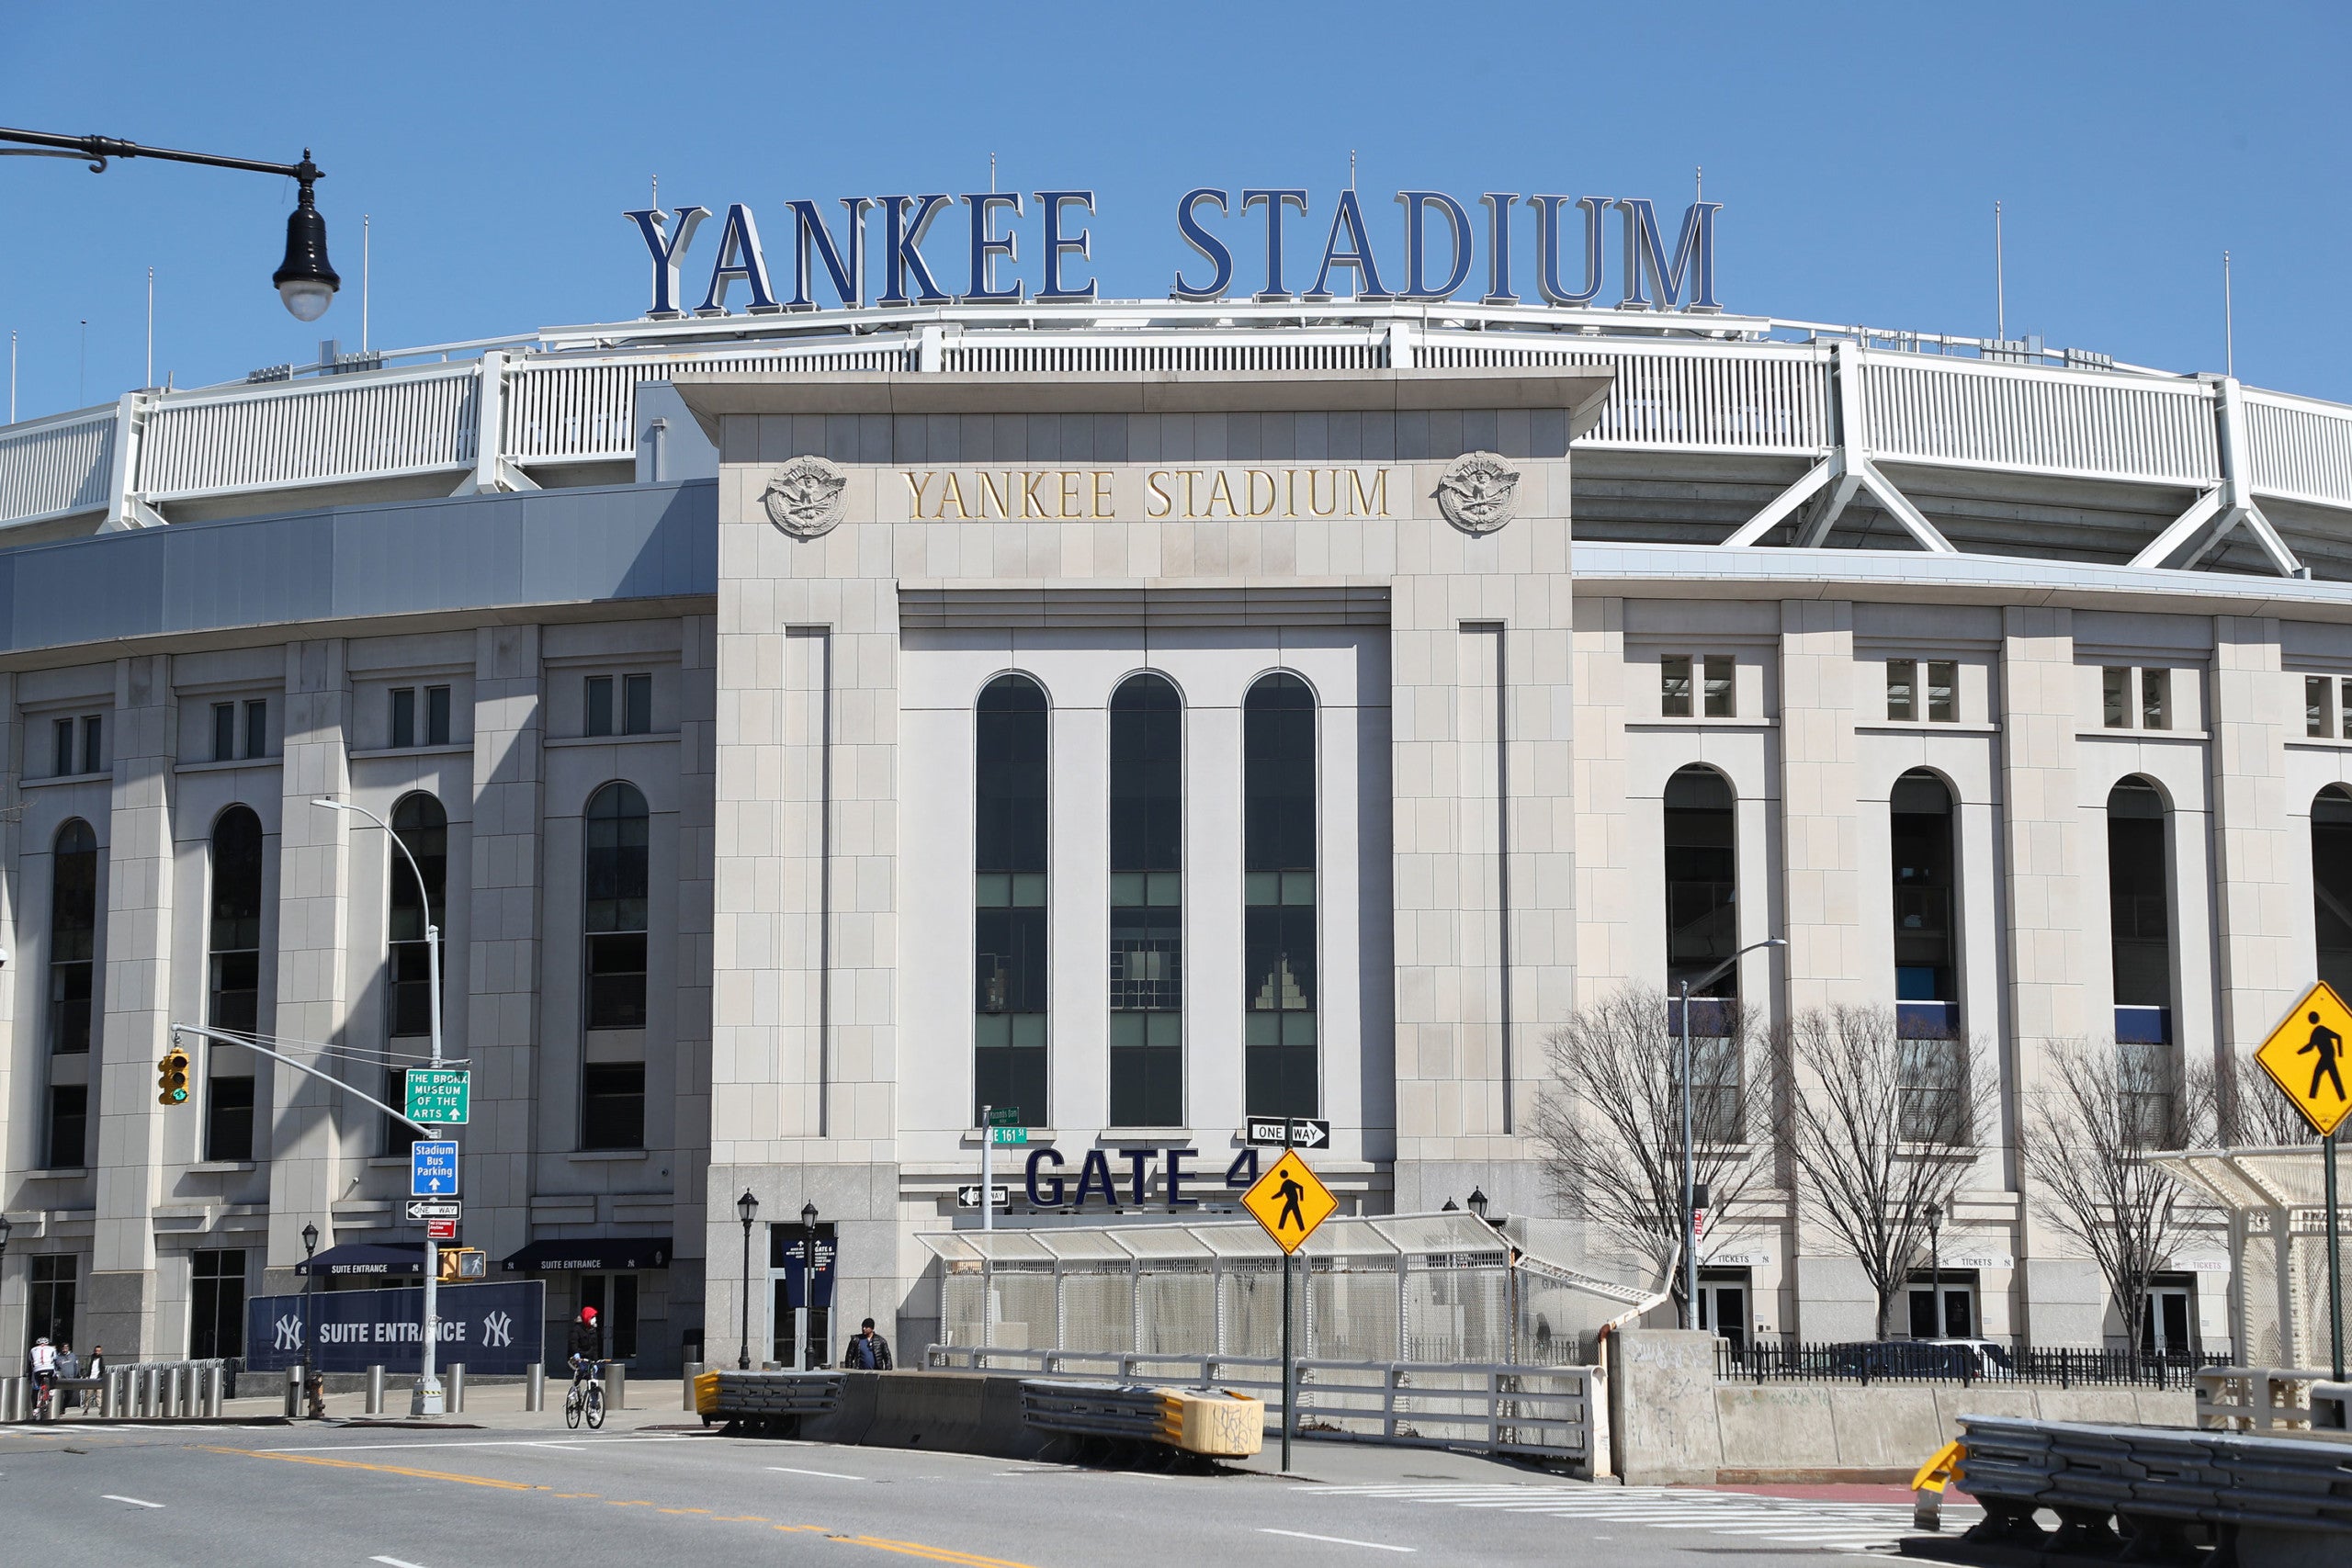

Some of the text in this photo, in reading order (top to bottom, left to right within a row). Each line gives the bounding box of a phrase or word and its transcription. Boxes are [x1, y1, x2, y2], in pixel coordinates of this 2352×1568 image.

[624, 188, 1723, 320] YANKEE STADIUM
[899, 468, 1391, 520] YANKEE STADIUM
[409, 1074, 468, 1084] THE BRONX
[415, 1086, 460, 1095] MUSEUM
[417, 1097, 458, 1106] OF THE
[413, 1109, 442, 1118] ARTS
[994, 1129, 999, 1142] E
[1002, 1129, 1016, 1142] 161
[1259, 1127, 1317, 1140] ONE WAY
[416, 1145, 454, 1156] Stadium
[426, 1156, 444, 1166] Bus
[417, 1166, 453, 1178] Parking
[1025, 1148, 1259, 1209] GATE 4
[413, 1206, 430, 1214] ONE
[541, 1259, 562, 1269] SUITE
[563, 1259, 601, 1269] ENTRANCE
[1718, 1255, 1749, 1263] TICKETS
[332, 1264, 351, 1274] SUITE
[352, 1264, 388, 1273] ENTRANCE
[2193, 1261, 2222, 1269] TICKETS
[319, 1323, 369, 1343] SUITE
